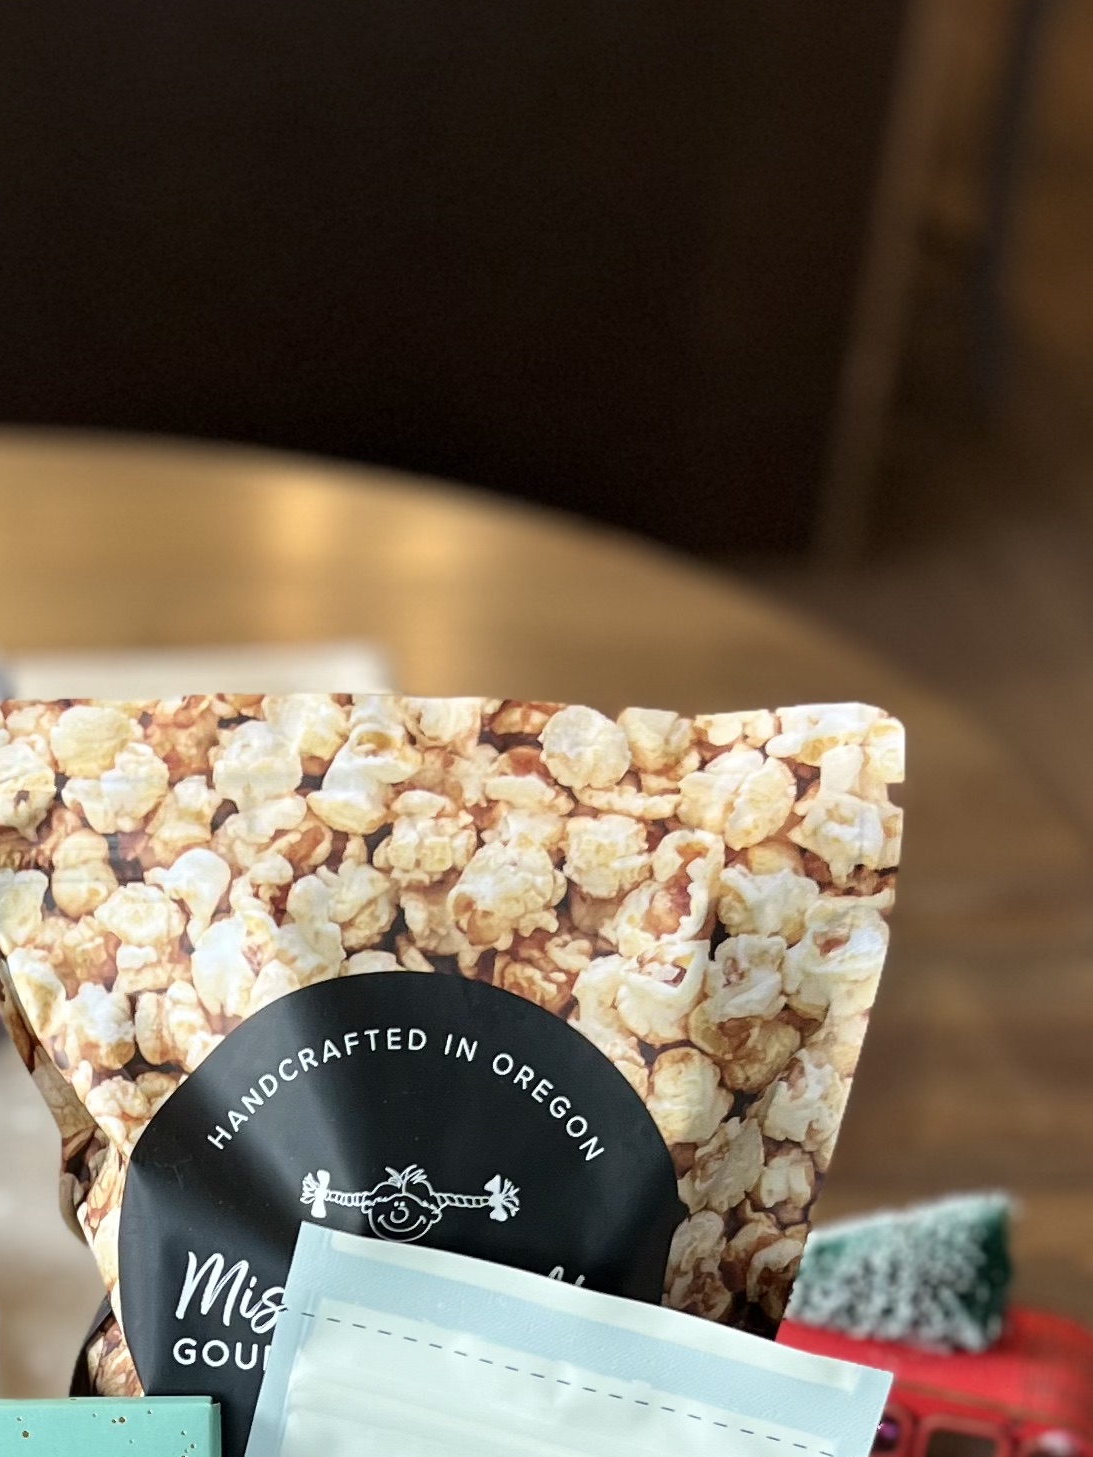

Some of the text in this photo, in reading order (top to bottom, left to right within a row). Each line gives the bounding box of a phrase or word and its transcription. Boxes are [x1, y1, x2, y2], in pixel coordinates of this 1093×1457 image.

[207, 1028, 605, 1162] HANDCRAFTED IN OREGON
